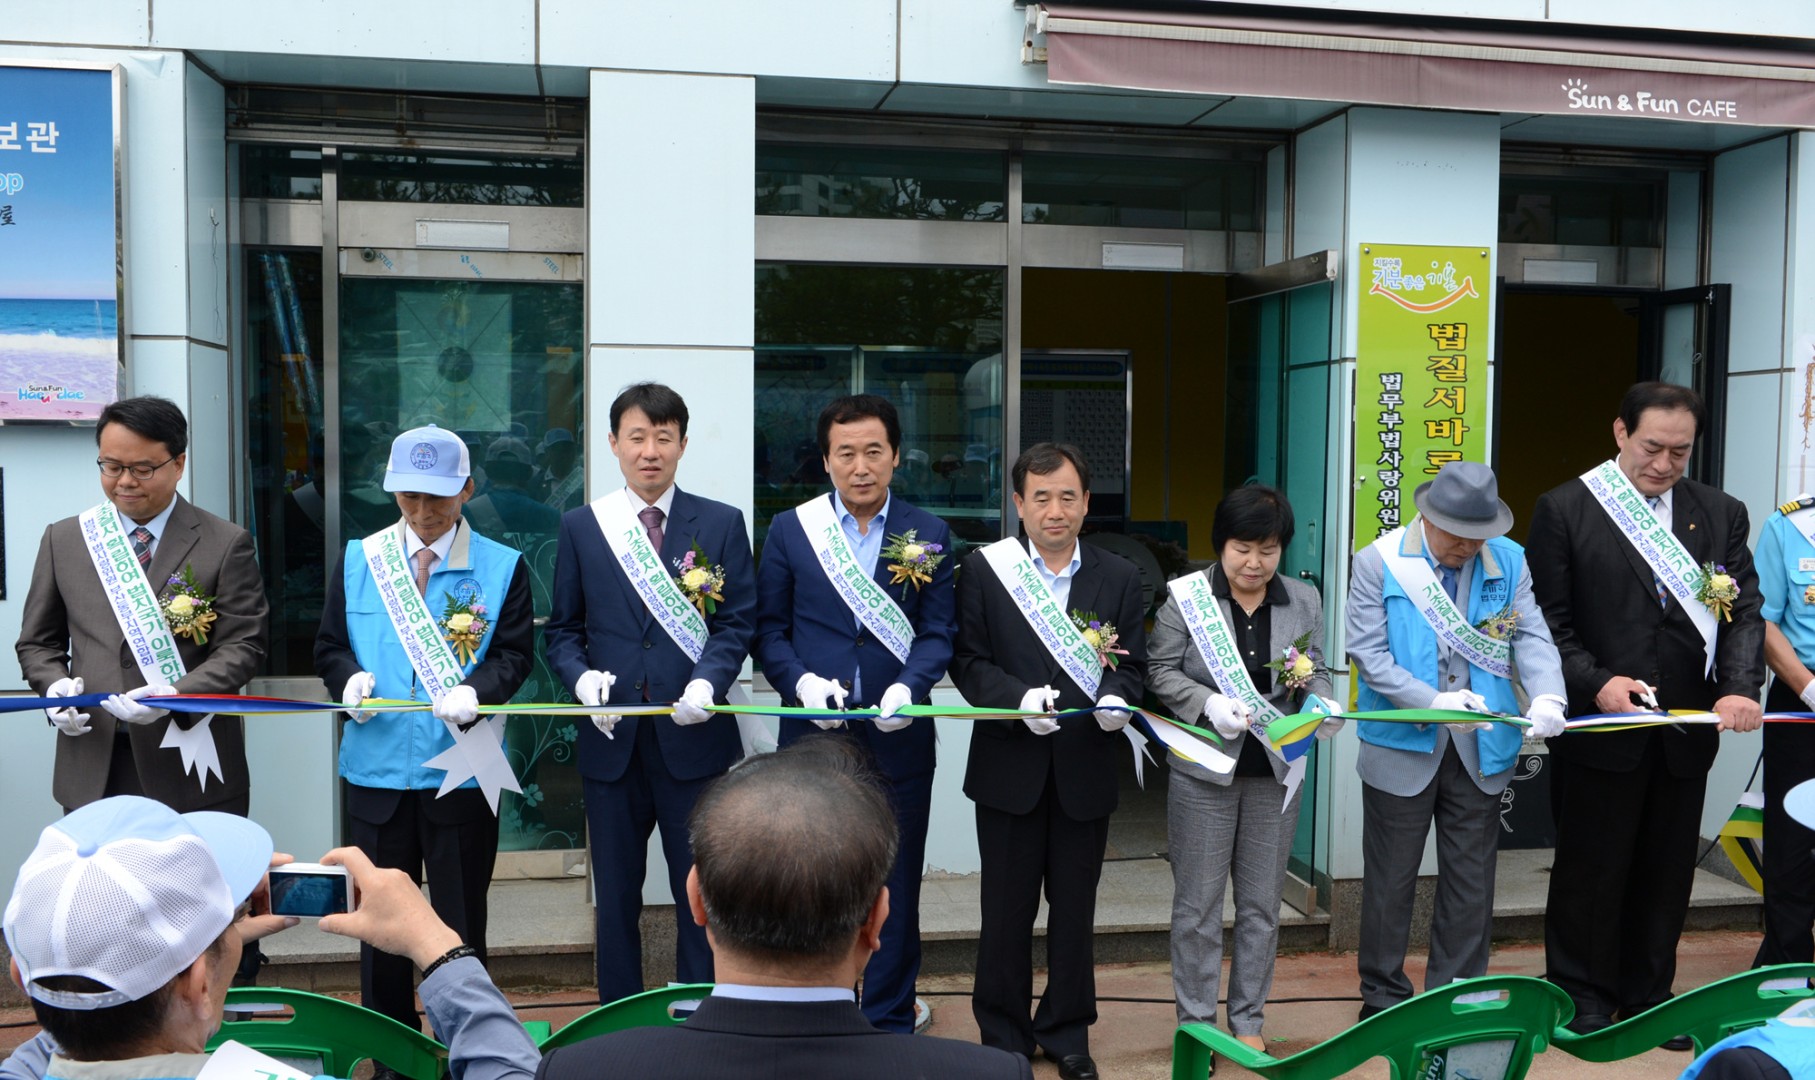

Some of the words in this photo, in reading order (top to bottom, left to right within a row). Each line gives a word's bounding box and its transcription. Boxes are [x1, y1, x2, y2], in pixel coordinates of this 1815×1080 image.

[1568, 87, 1612, 110] Sun
[1617, 94, 1633, 111] &
[1636, 91, 1679, 114] Fun
[1687, 99, 1737, 118] CAFE
[1377, 371, 1404, 540] 법무부법사랑위원
[1588, 476, 1609, 498] 법무부
[1604, 495, 1638, 534] 법사랑위원
[1617, 488, 1658, 531] 확립하여
[1649, 527, 1691, 572] 법치국가
[84, 518, 99, 542] 법무부
[92, 542, 117, 585] 법사랑위원
[106, 535, 140, 584] 확립하여
[127, 582, 166, 635] 법치국가
[621, 552, 641, 578] 법무부
[637, 578, 670, 620] 법사랑위원
[624, 526, 658, 574] 기초질서
[650, 570, 690, 617] 확립하여
[820, 548, 837, 573] 법무부
[833, 573, 867, 614] 법사랑위원
[824, 523, 852, 568] 기초질서
[845, 564, 886, 609] 확립하여
[371, 554, 387, 580] 법무부
[381, 581, 406, 626] 법사랑위원
[379, 531, 405, 577] 기초질서
[393, 574, 427, 624] 확립하여
[415, 623, 454, 673] 법치국가
[1012, 585, 1033, 610] 법무부
[1029, 610, 1062, 651] 법사랑위원
[1013, 559, 1050, 606] 기초질서
[1041, 601, 1080, 647] 확립하여
[1187, 578, 1217, 622] 기초질서
[1206, 621, 1238, 669] 확립하여
[1422, 581, 1460, 627] 기초질서
[1454, 623, 1498, 655] 확립하여
[1481, 594, 1506, 602] 법무부
[1181, 598, 1199, 625] 법무부
[1193, 625, 1220, 669] 법사랑위원
[1424, 606, 1445, 631] 법무부
[1443, 630, 1482, 661] 법사랑위원
